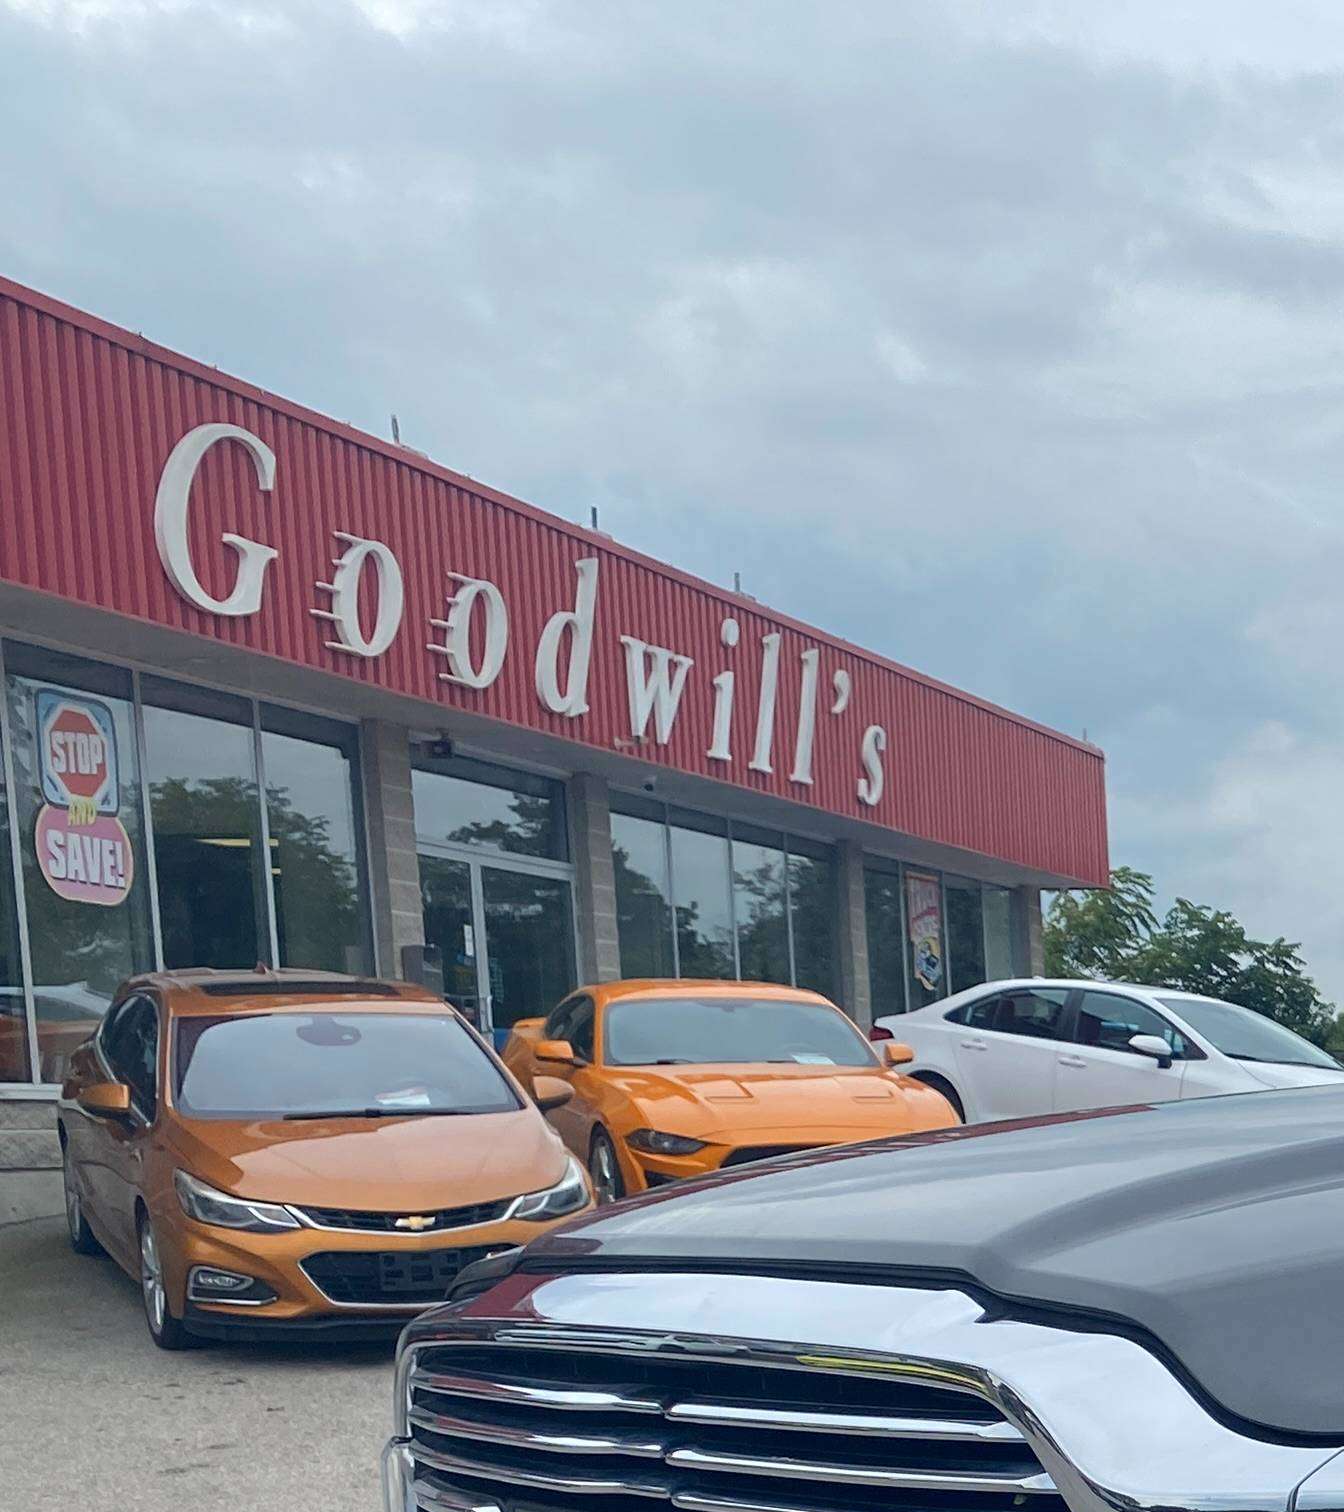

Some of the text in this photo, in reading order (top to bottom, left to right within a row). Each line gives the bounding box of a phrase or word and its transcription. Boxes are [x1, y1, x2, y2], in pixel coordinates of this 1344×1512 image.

[154, 422, 887, 806] Goodwill's
[51, 731, 104, 775] STOP
[68, 797, 97, 827] AND
[47, 828, 126, 890] SAVE!
